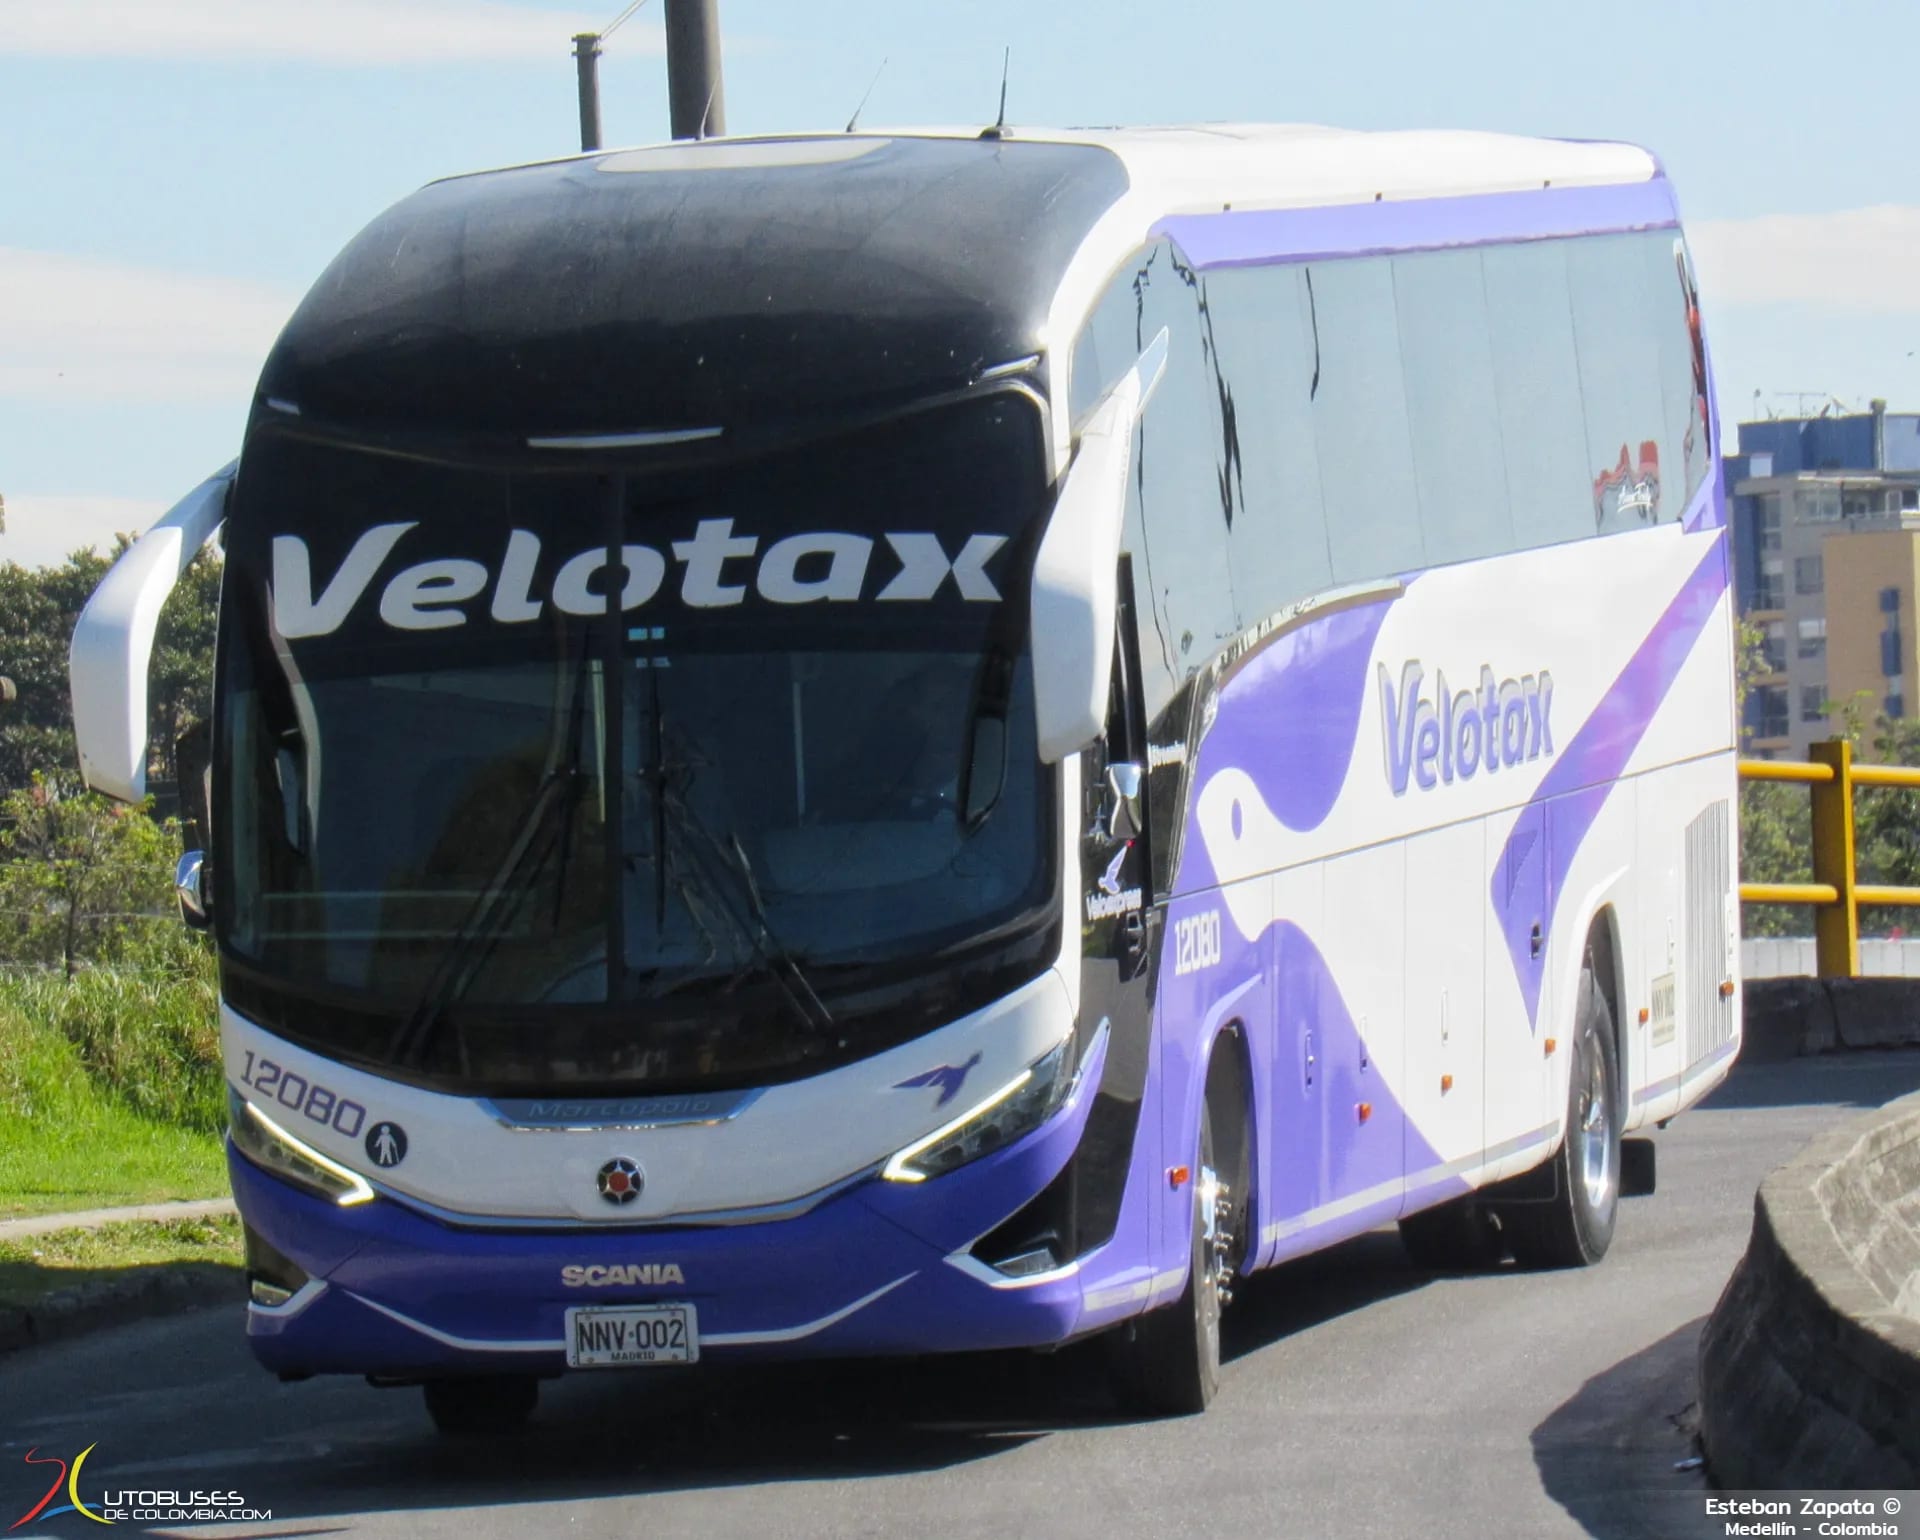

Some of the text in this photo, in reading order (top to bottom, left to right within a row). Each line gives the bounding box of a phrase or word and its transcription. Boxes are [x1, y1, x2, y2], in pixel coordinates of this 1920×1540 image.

[271, 518, 1010, 639] Velotax
[1376, 657, 1555, 798] Velotax
[1174, 908, 1221, 977] 12080
[240, 1049, 367, 1140] 12080
[528, 1096, 711, 1119] Marcopolo
[561, 1263, 685, 1288] SCANIA
[611, 1350, 656, 1361] MADRID
